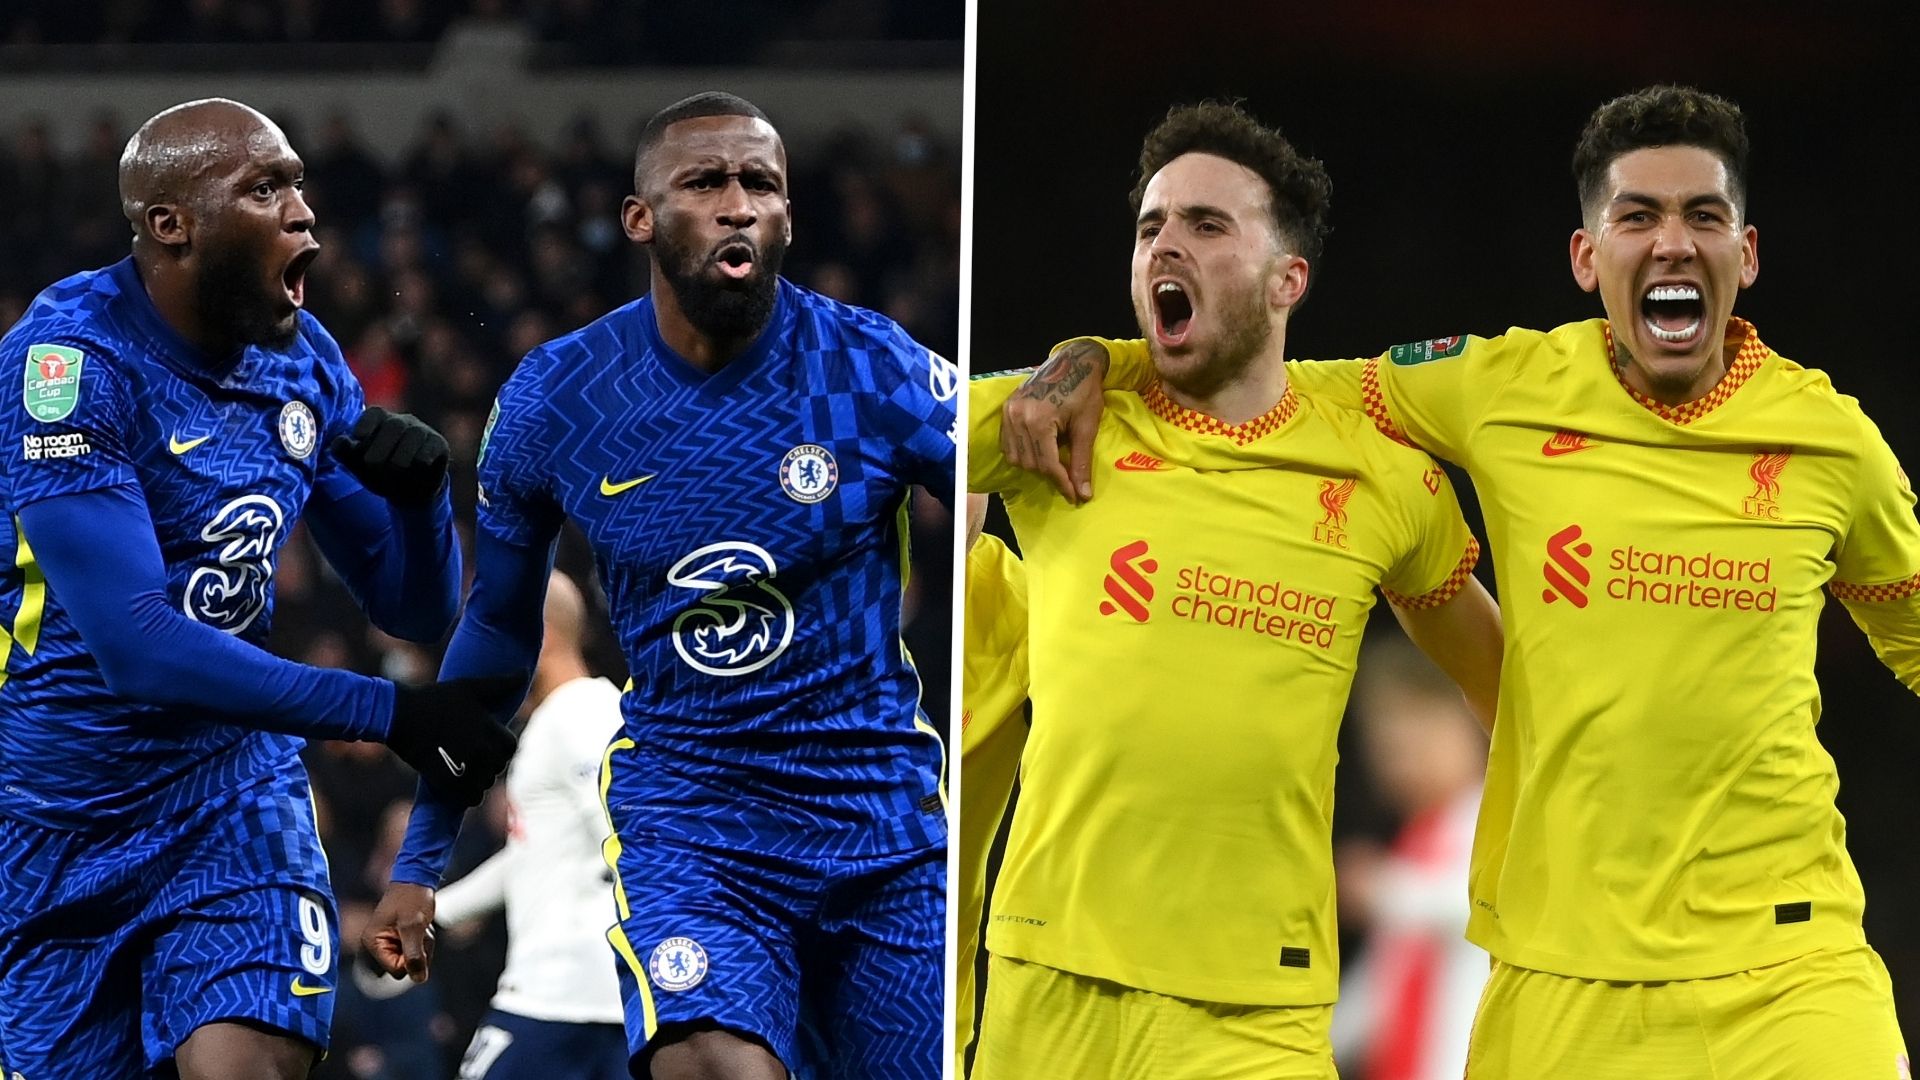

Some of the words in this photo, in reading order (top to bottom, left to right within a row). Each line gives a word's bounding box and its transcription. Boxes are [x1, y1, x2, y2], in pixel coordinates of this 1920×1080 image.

[28, 376, 75, 391] Carabao
[39, 387, 61, 398] Cup
[23, 434, 42, 448] No
[44, 433, 83, 447] room
[24, 445, 43, 460] for
[44, 443, 91, 459] racism
[1126, 451, 1164, 469] NIKE
[1609, 545, 1771, 584] standard
[1176, 566, 1337, 621] standard
[1606, 574, 1777, 613] chartered
[1171, 594, 1337, 649] chartered
[298, 895, 331, 975] 9
